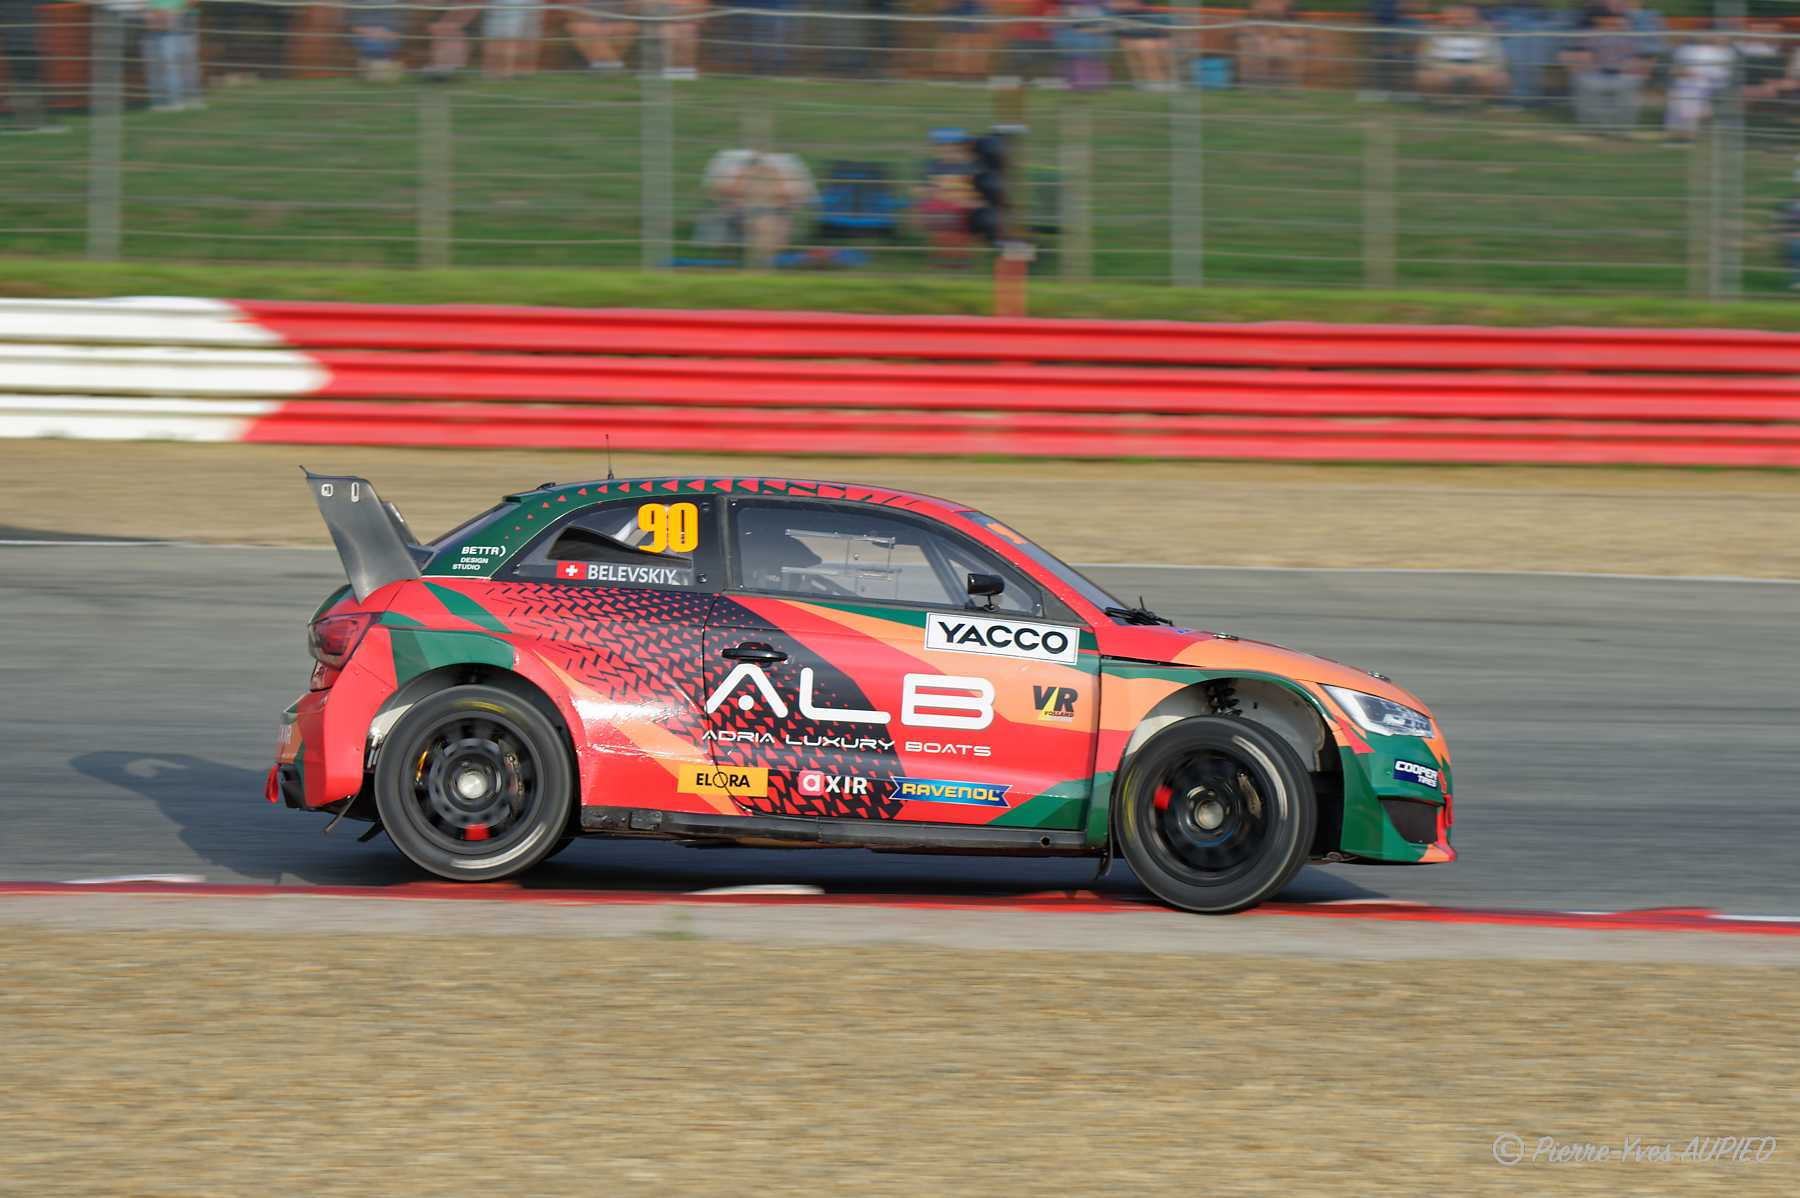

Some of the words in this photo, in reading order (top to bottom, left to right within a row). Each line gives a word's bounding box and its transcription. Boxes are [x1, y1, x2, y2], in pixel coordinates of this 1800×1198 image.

[638, 502, 698, 554] 90
[452, 563, 481, 571] STUDIO
[588, 564, 678, 585] BELEVSKIY
[938, 621, 1068, 655] YACCO
[702, 730, 775, 744] ADRIA
[786, 734, 895, 750] LUXURY
[905, 741, 992, 757] BOATS
[696, 770, 750, 789] ELORA
[1395, 760, 1438, 780] COOPER
[902, 783, 1001, 801] RAVENOL
